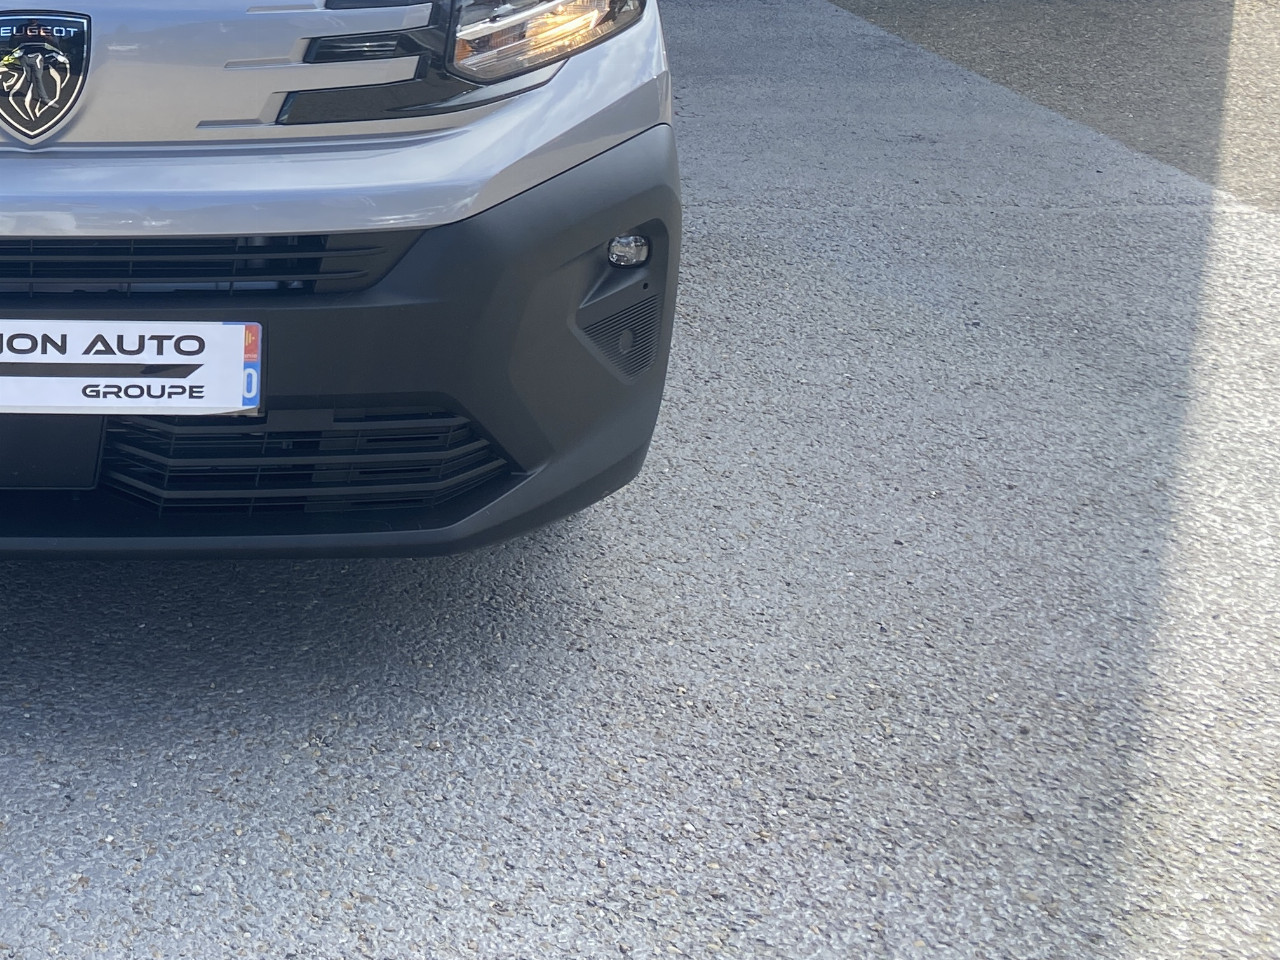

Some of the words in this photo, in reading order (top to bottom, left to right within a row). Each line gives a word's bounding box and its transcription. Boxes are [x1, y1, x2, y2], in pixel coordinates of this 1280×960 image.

[81, 333, 207, 357] AUTO
[81, 384, 206, 400] GROUPE
[243, 367, 258, 399] 0
